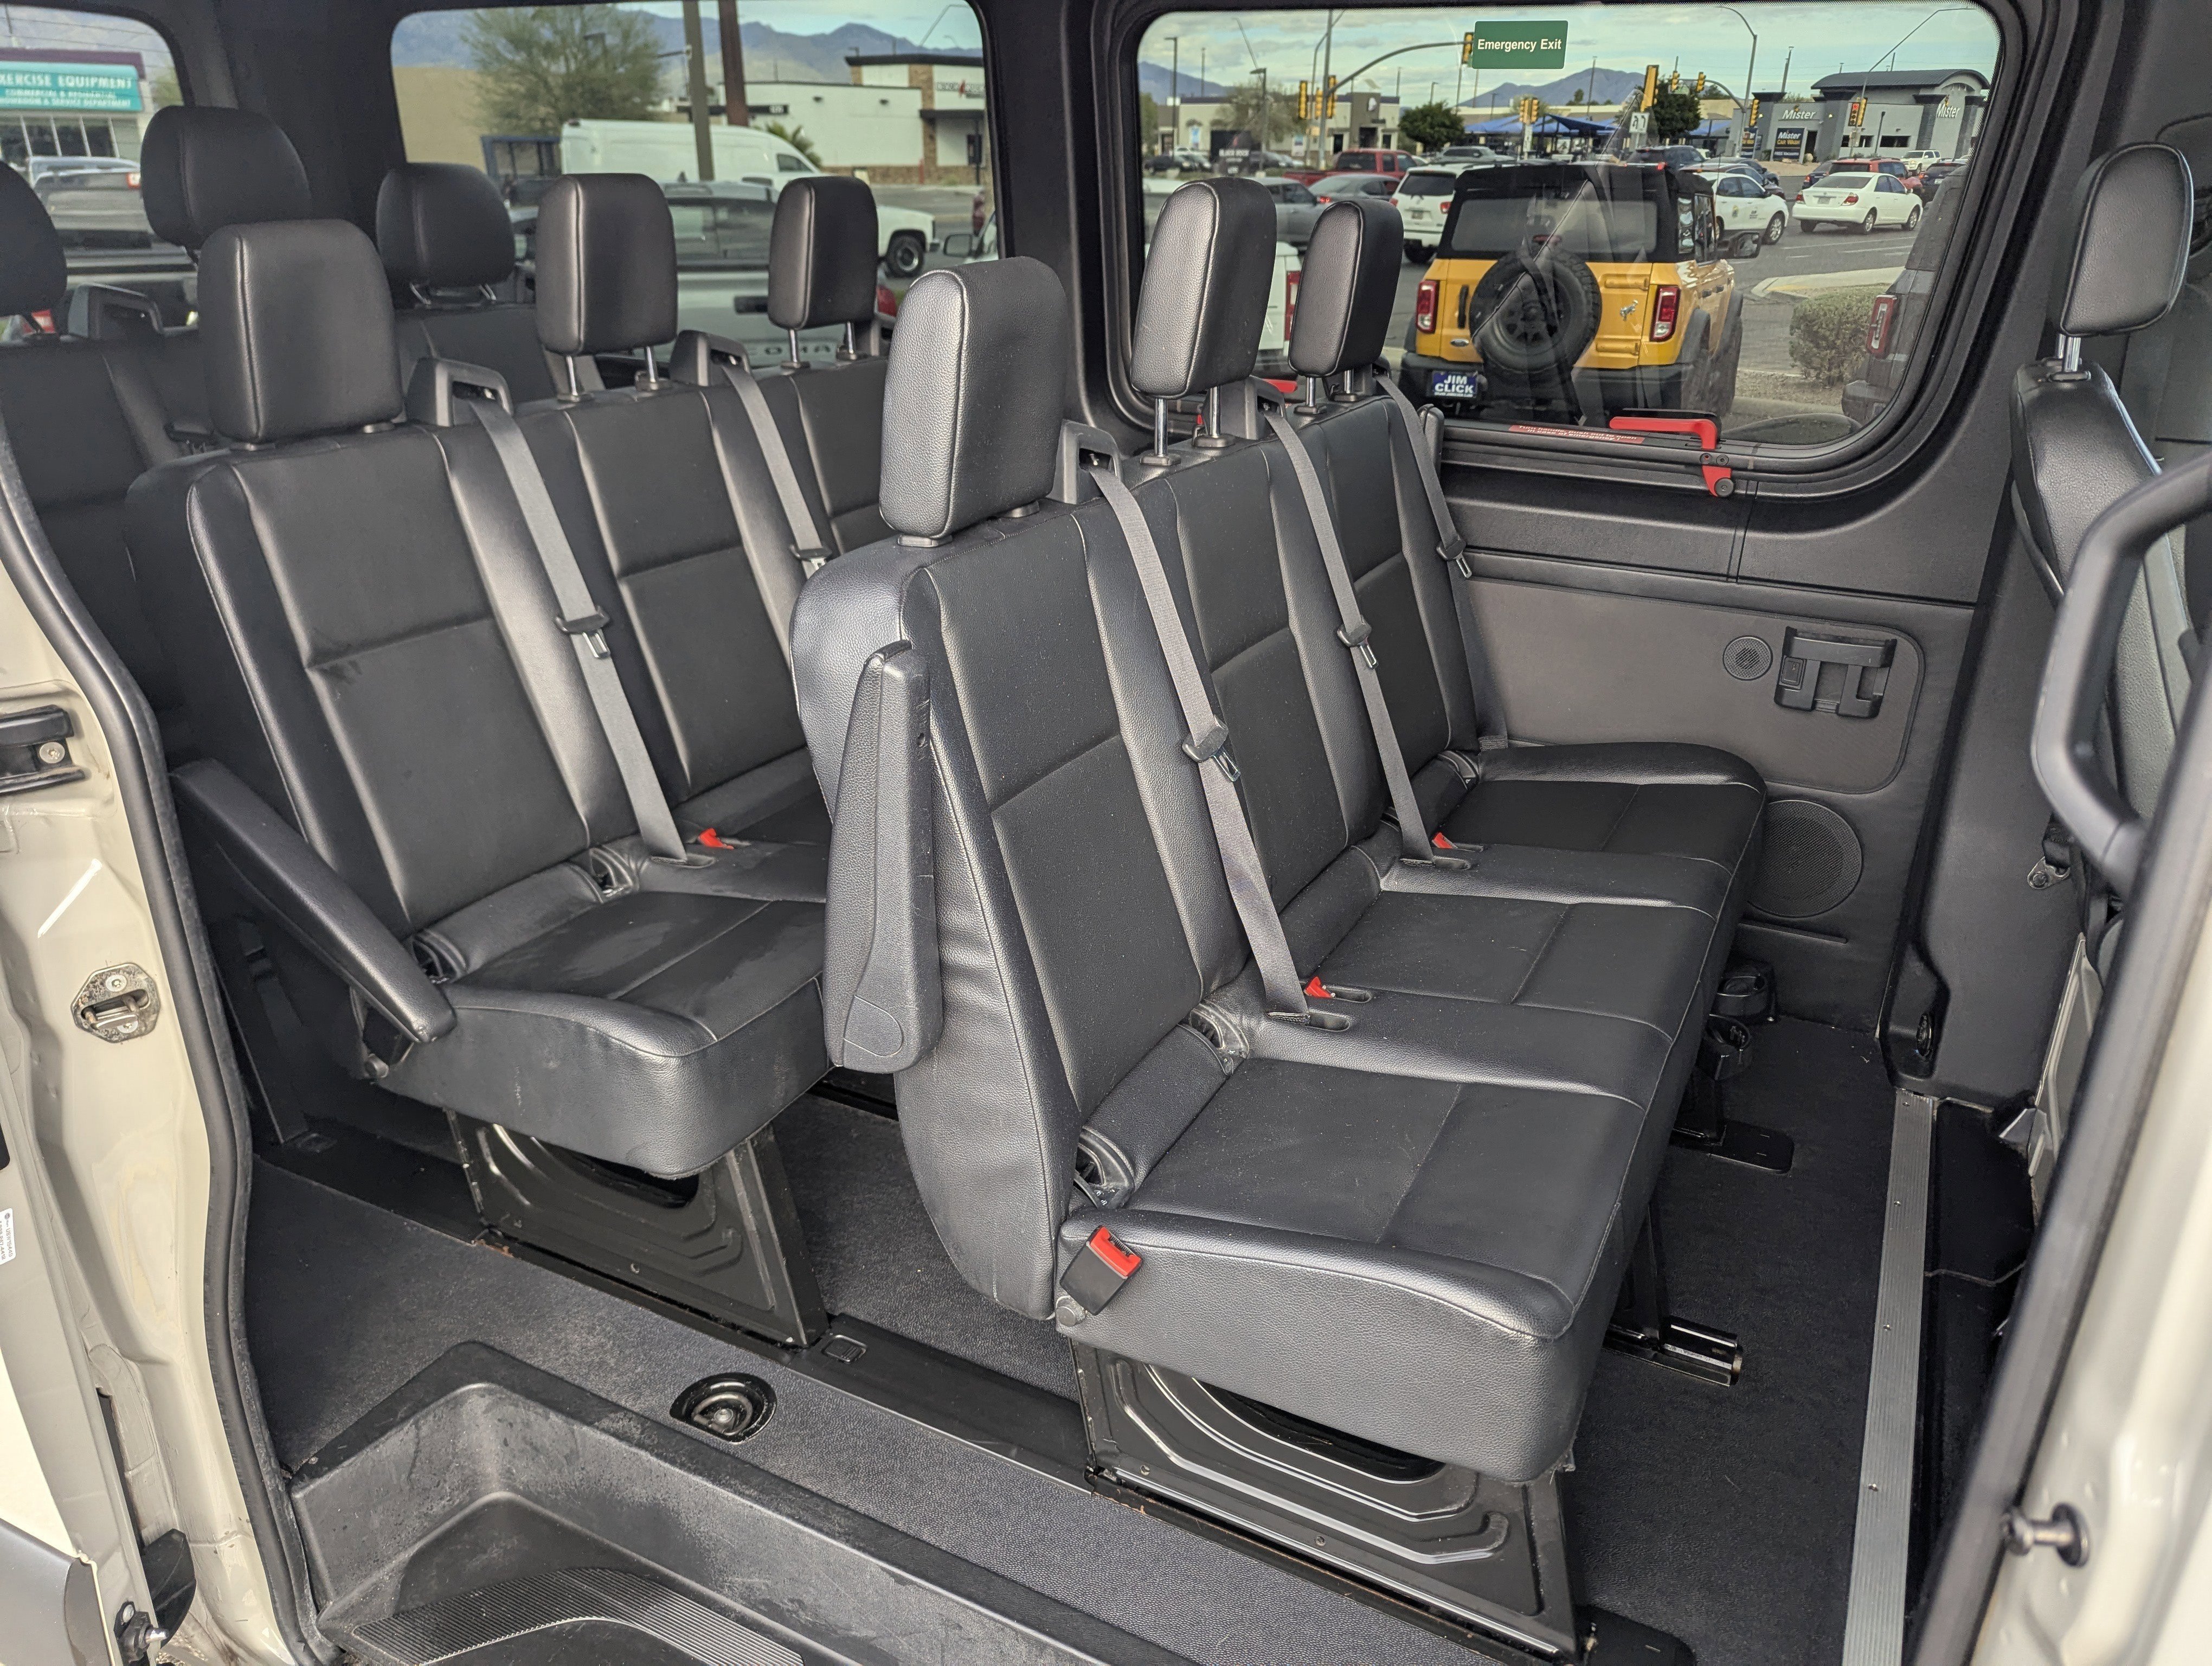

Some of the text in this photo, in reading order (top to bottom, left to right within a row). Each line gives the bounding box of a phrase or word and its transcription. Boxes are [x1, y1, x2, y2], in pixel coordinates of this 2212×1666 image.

[1477, 39, 1562, 52] Emergency Exit
[58, 75, 131, 89] EQUIPMENT
[1782, 110, 1816, 119] Mister
[1936, 103, 1960, 118] Mister
[1444, 375, 1468, 385] JIM
[1435, 383, 1474, 394] CLICK
